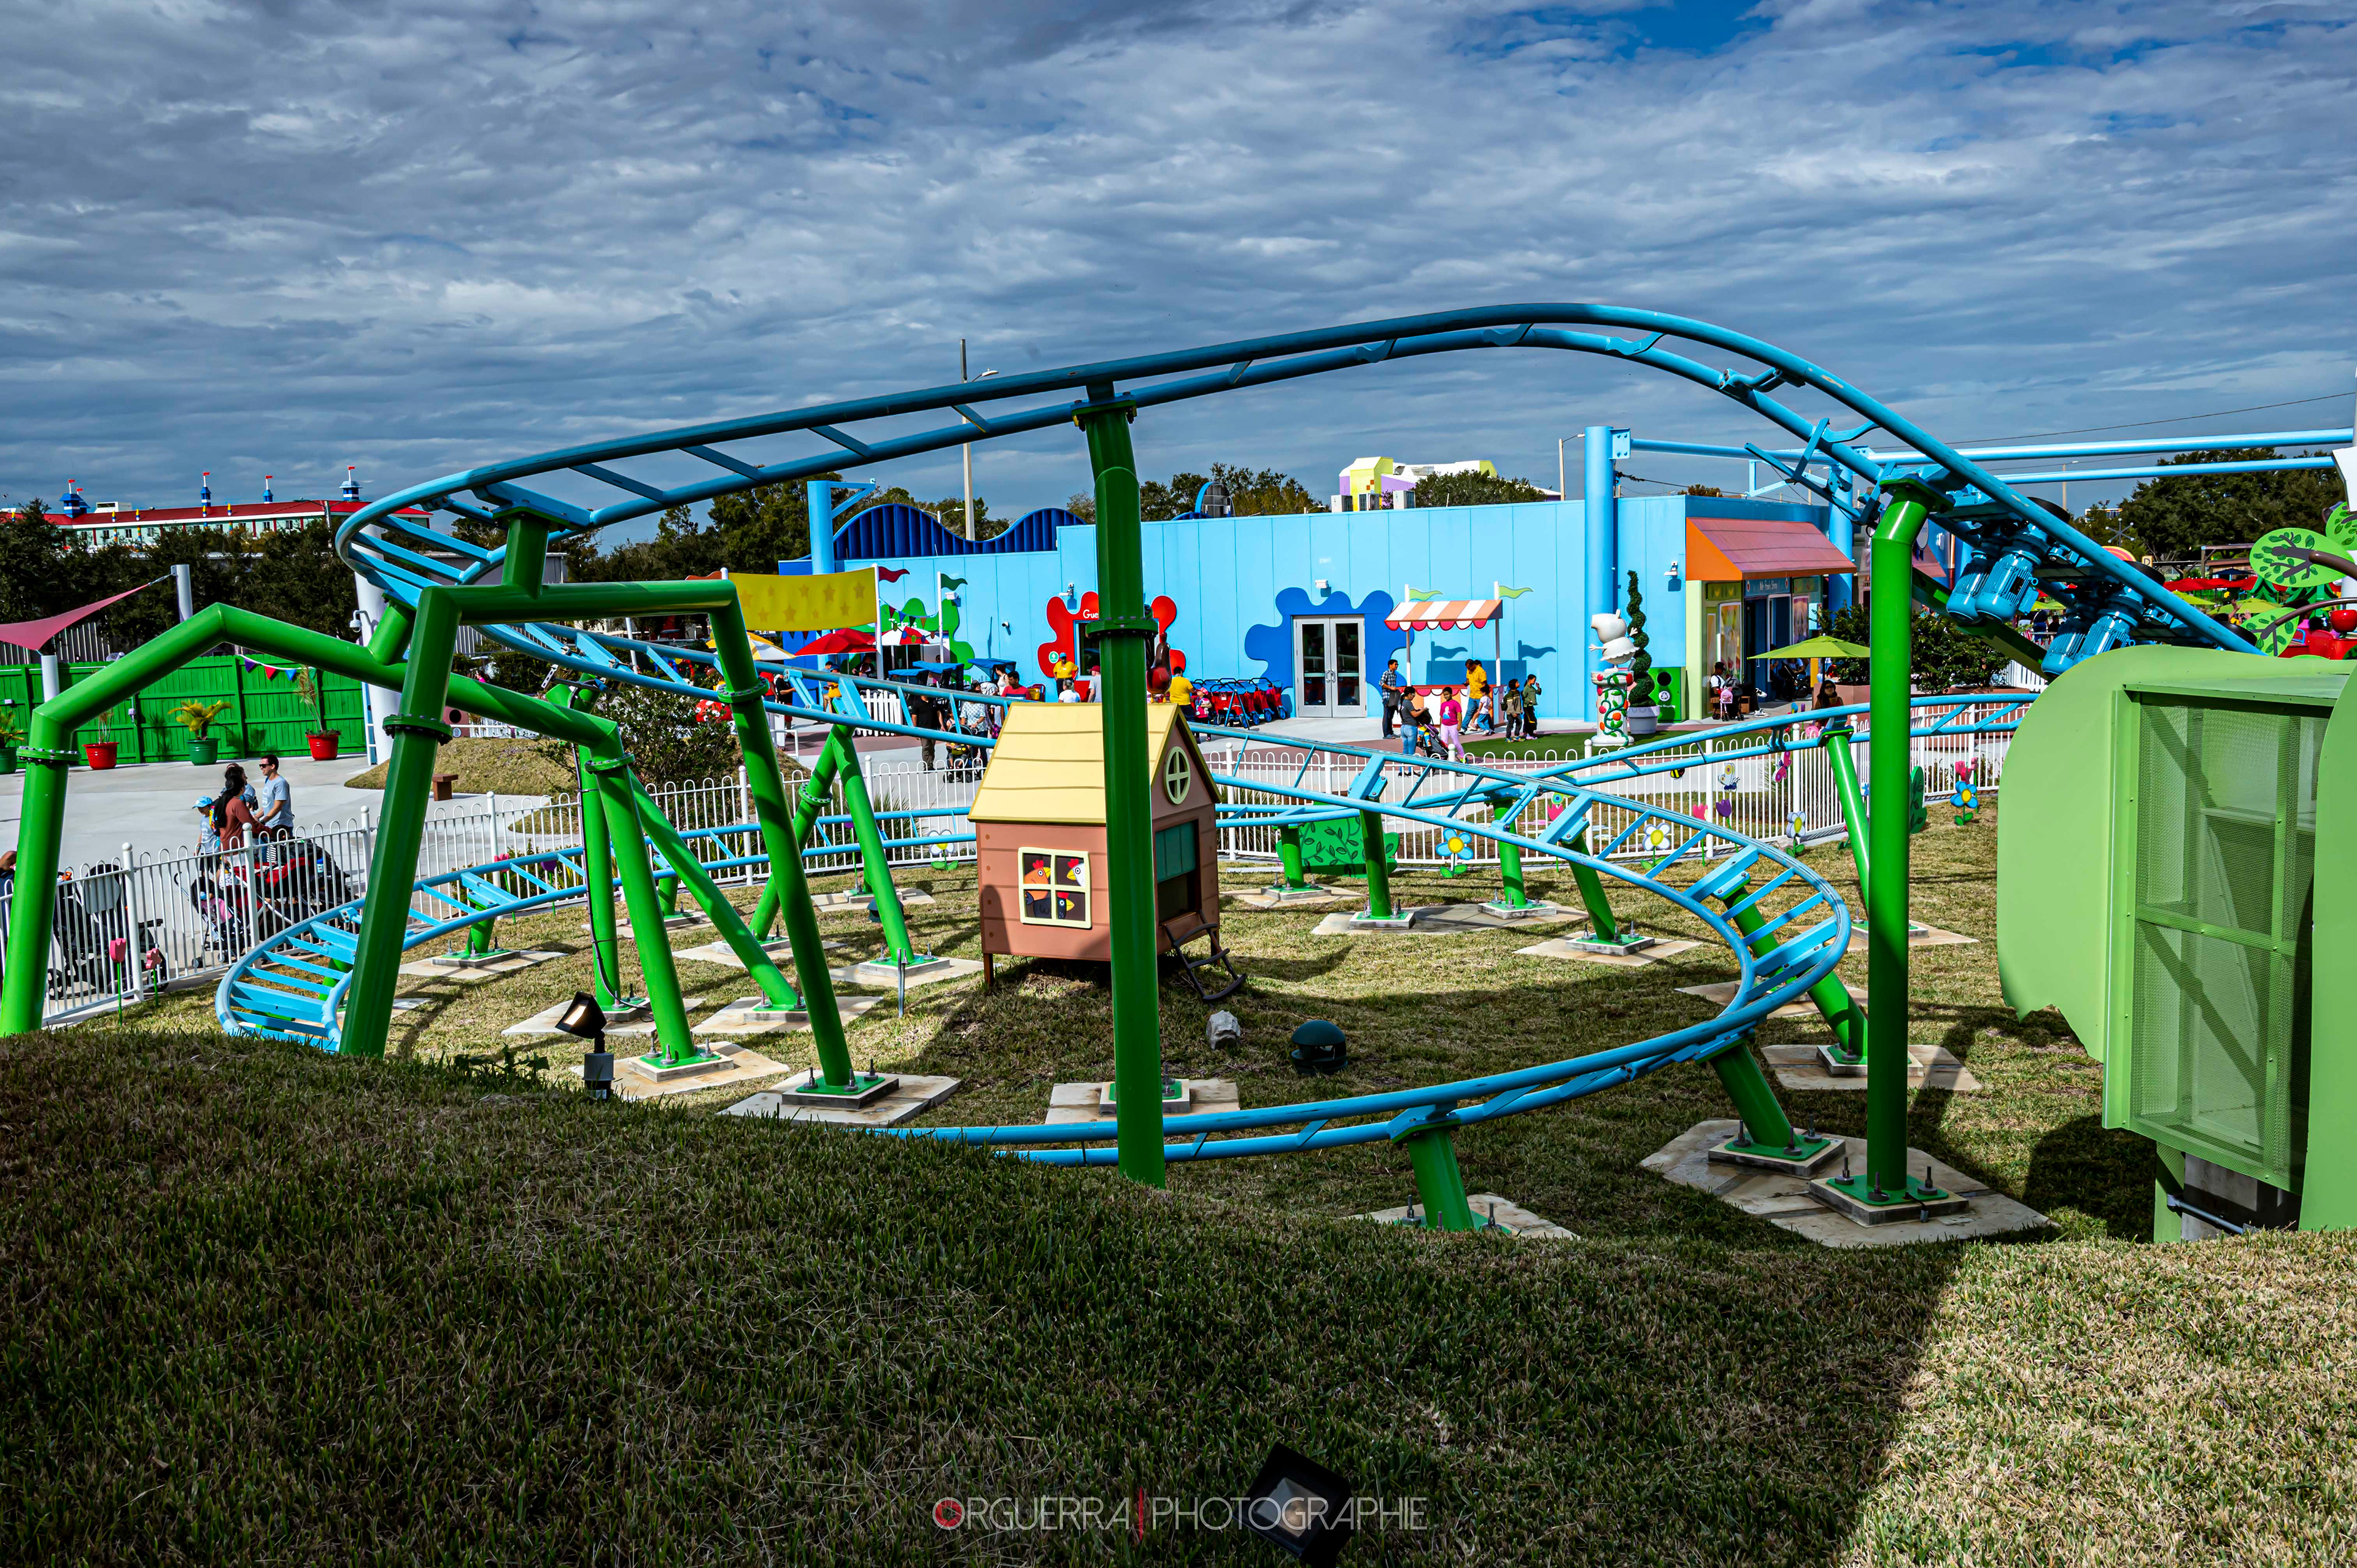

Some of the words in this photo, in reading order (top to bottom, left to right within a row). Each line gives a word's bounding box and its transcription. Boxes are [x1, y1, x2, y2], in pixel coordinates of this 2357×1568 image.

[1759, 581, 1764, 591] Mr
[1083, 609, 1099, 619] Gue
[888, 618, 917, 629] Tckes
